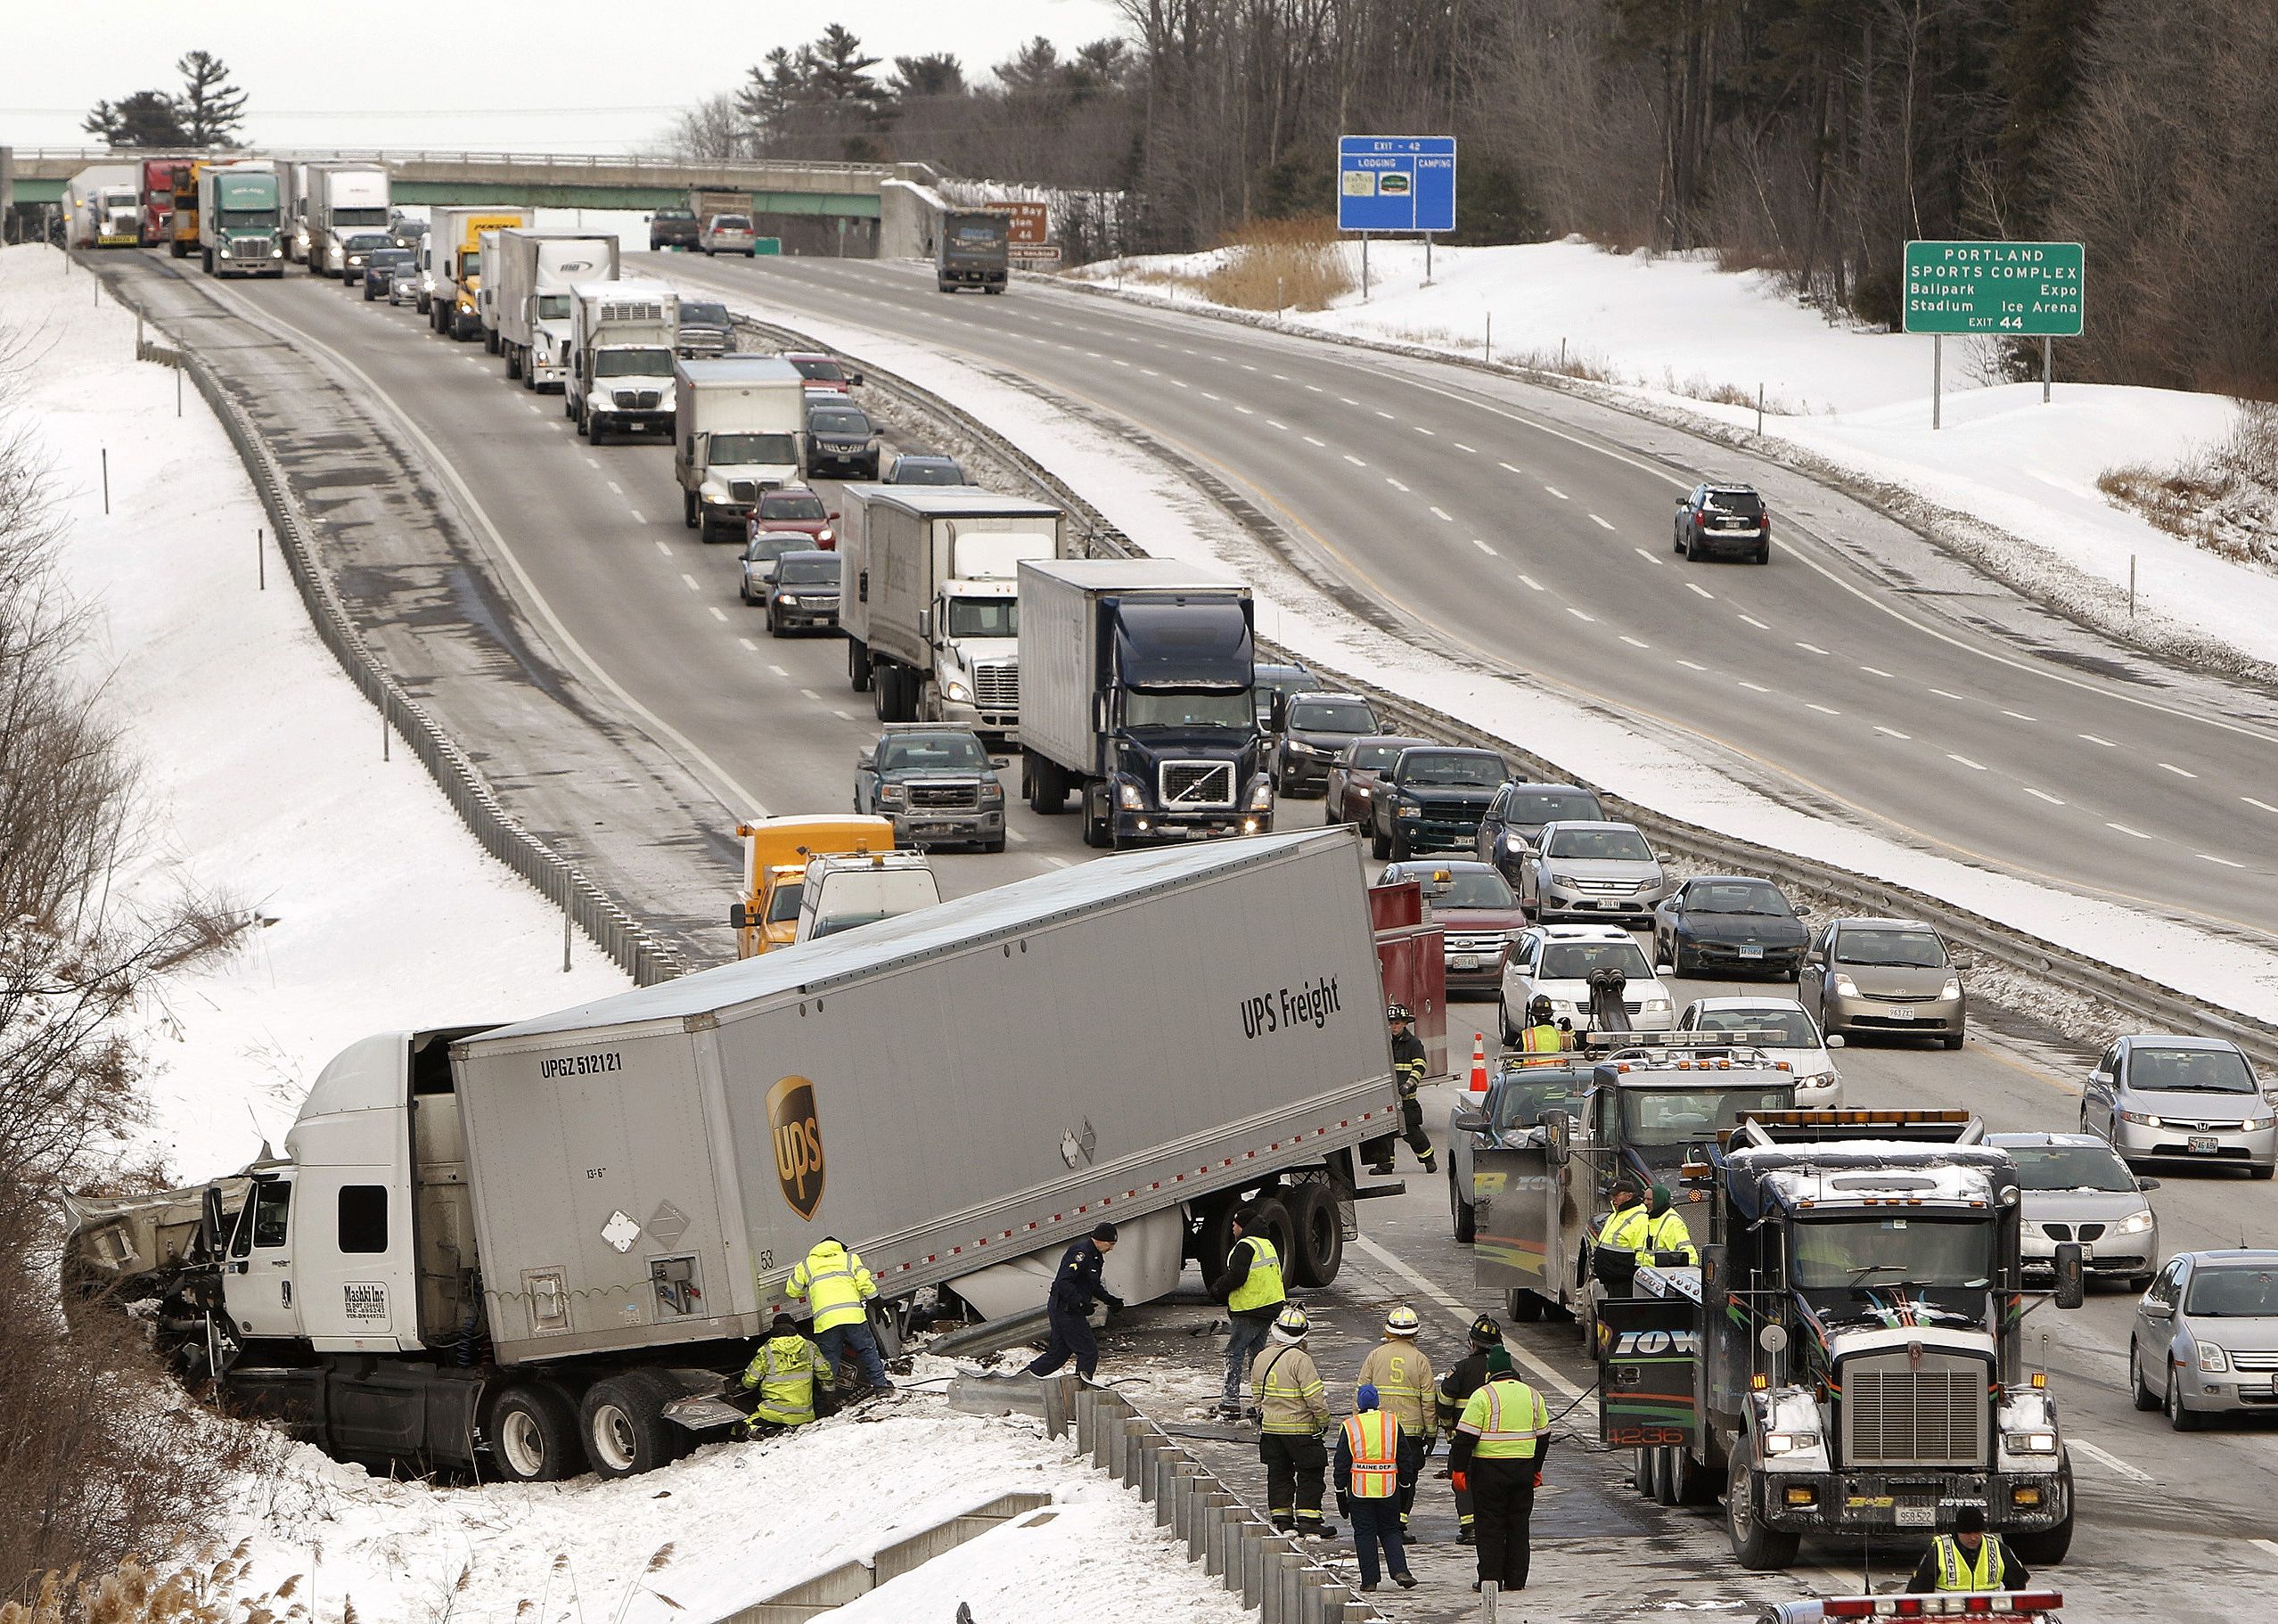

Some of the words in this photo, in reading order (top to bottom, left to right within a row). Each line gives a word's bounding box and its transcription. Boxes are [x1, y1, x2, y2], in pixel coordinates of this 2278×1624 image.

[1374, 142, 1392, 151] EXIT
[1409, 142, 1421, 151] 42
[1358, 159, 1396, 168] LODGING
[1419, 160, 1452, 168] CAMPING
[1945, 250, 2044, 261] PORTLAND
[1912, 266, 1983, 277] SPORTS
[1992, 267, 2077, 278] COMPLEX
[1911, 283, 1975, 296] Ballpark
[2041, 284, 2077, 298] Expo
[1911, 300, 1974, 312] Stadium
[2003, 301, 2024, 312] Ice
[2033, 301, 2077, 313] Arena
[1969, 318, 1993, 326] EXIT
[2000, 316, 2022, 329] 44
[1241, 993, 1276, 1039] UPS
[1280, 976, 1341, 1029] Freight
[540, 1058, 576, 1079] UPGZ
[577, 1053, 622, 1075] 512121
[774, 1117, 822, 1200] ups
[344, 1285, 371, 1302] Mashki
[372, 1285, 384, 1302] Inc
[1389, 1357, 1405, 1383] S
[1938, 1497, 1987, 1506] TOWING
[1945, 1545, 1955, 1579] STATE
[1989, 1540, 1997, 1584] TROOPER
